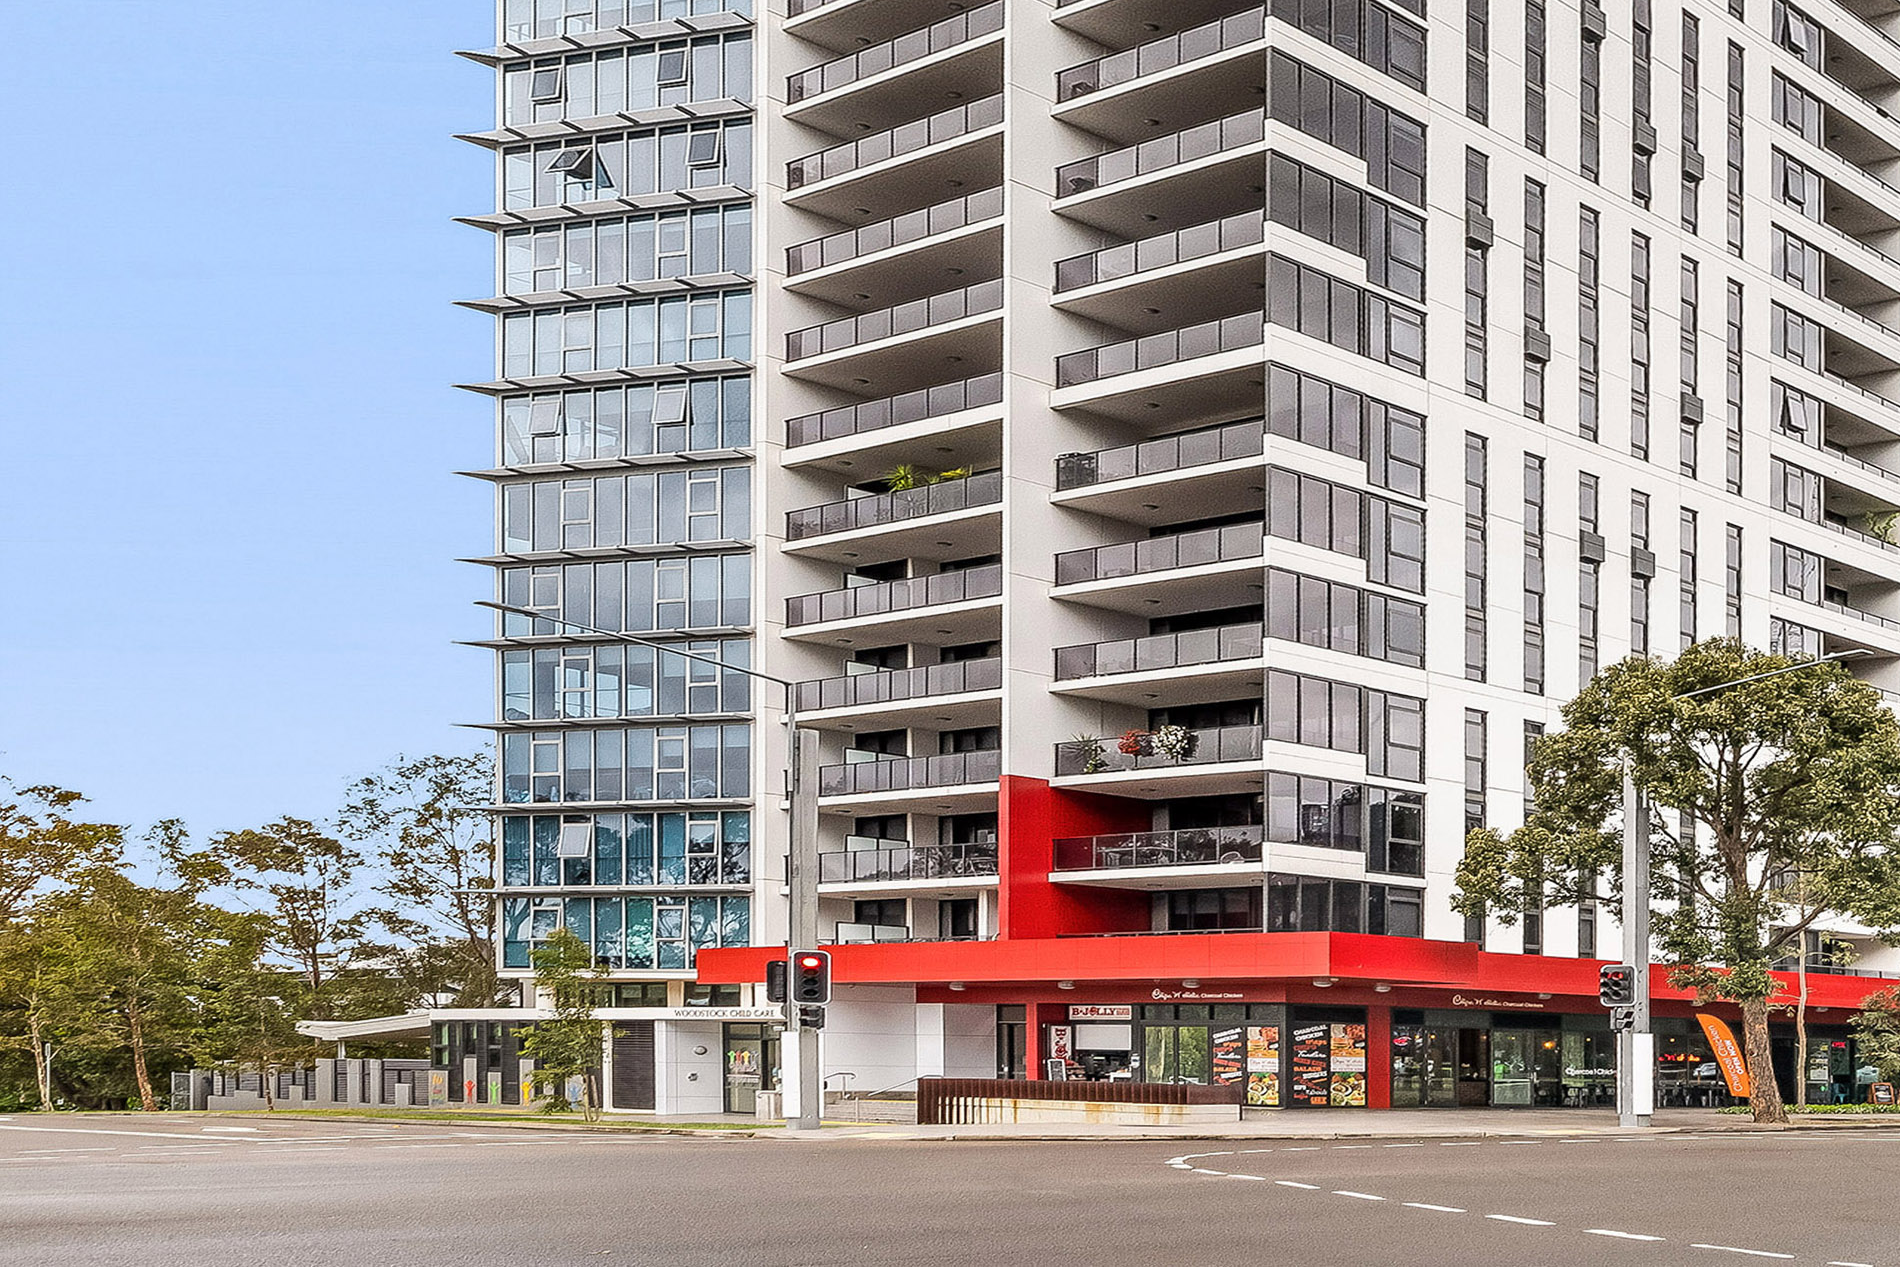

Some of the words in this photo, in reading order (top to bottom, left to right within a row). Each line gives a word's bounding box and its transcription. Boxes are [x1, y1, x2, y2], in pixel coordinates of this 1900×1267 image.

[674, 1009, 727, 1017] WOODSTOCK
[730, 1009, 751, 1017] CHILD
[754, 1009, 775, 1017] CARE
[1708, 1025, 1728, 1056] Chicken
[1724, 1040, 1737, 1056] NOW
[1722, 1057, 1743, 1091] Charcoal
[1732, 1057, 1744, 1075] OPEN
